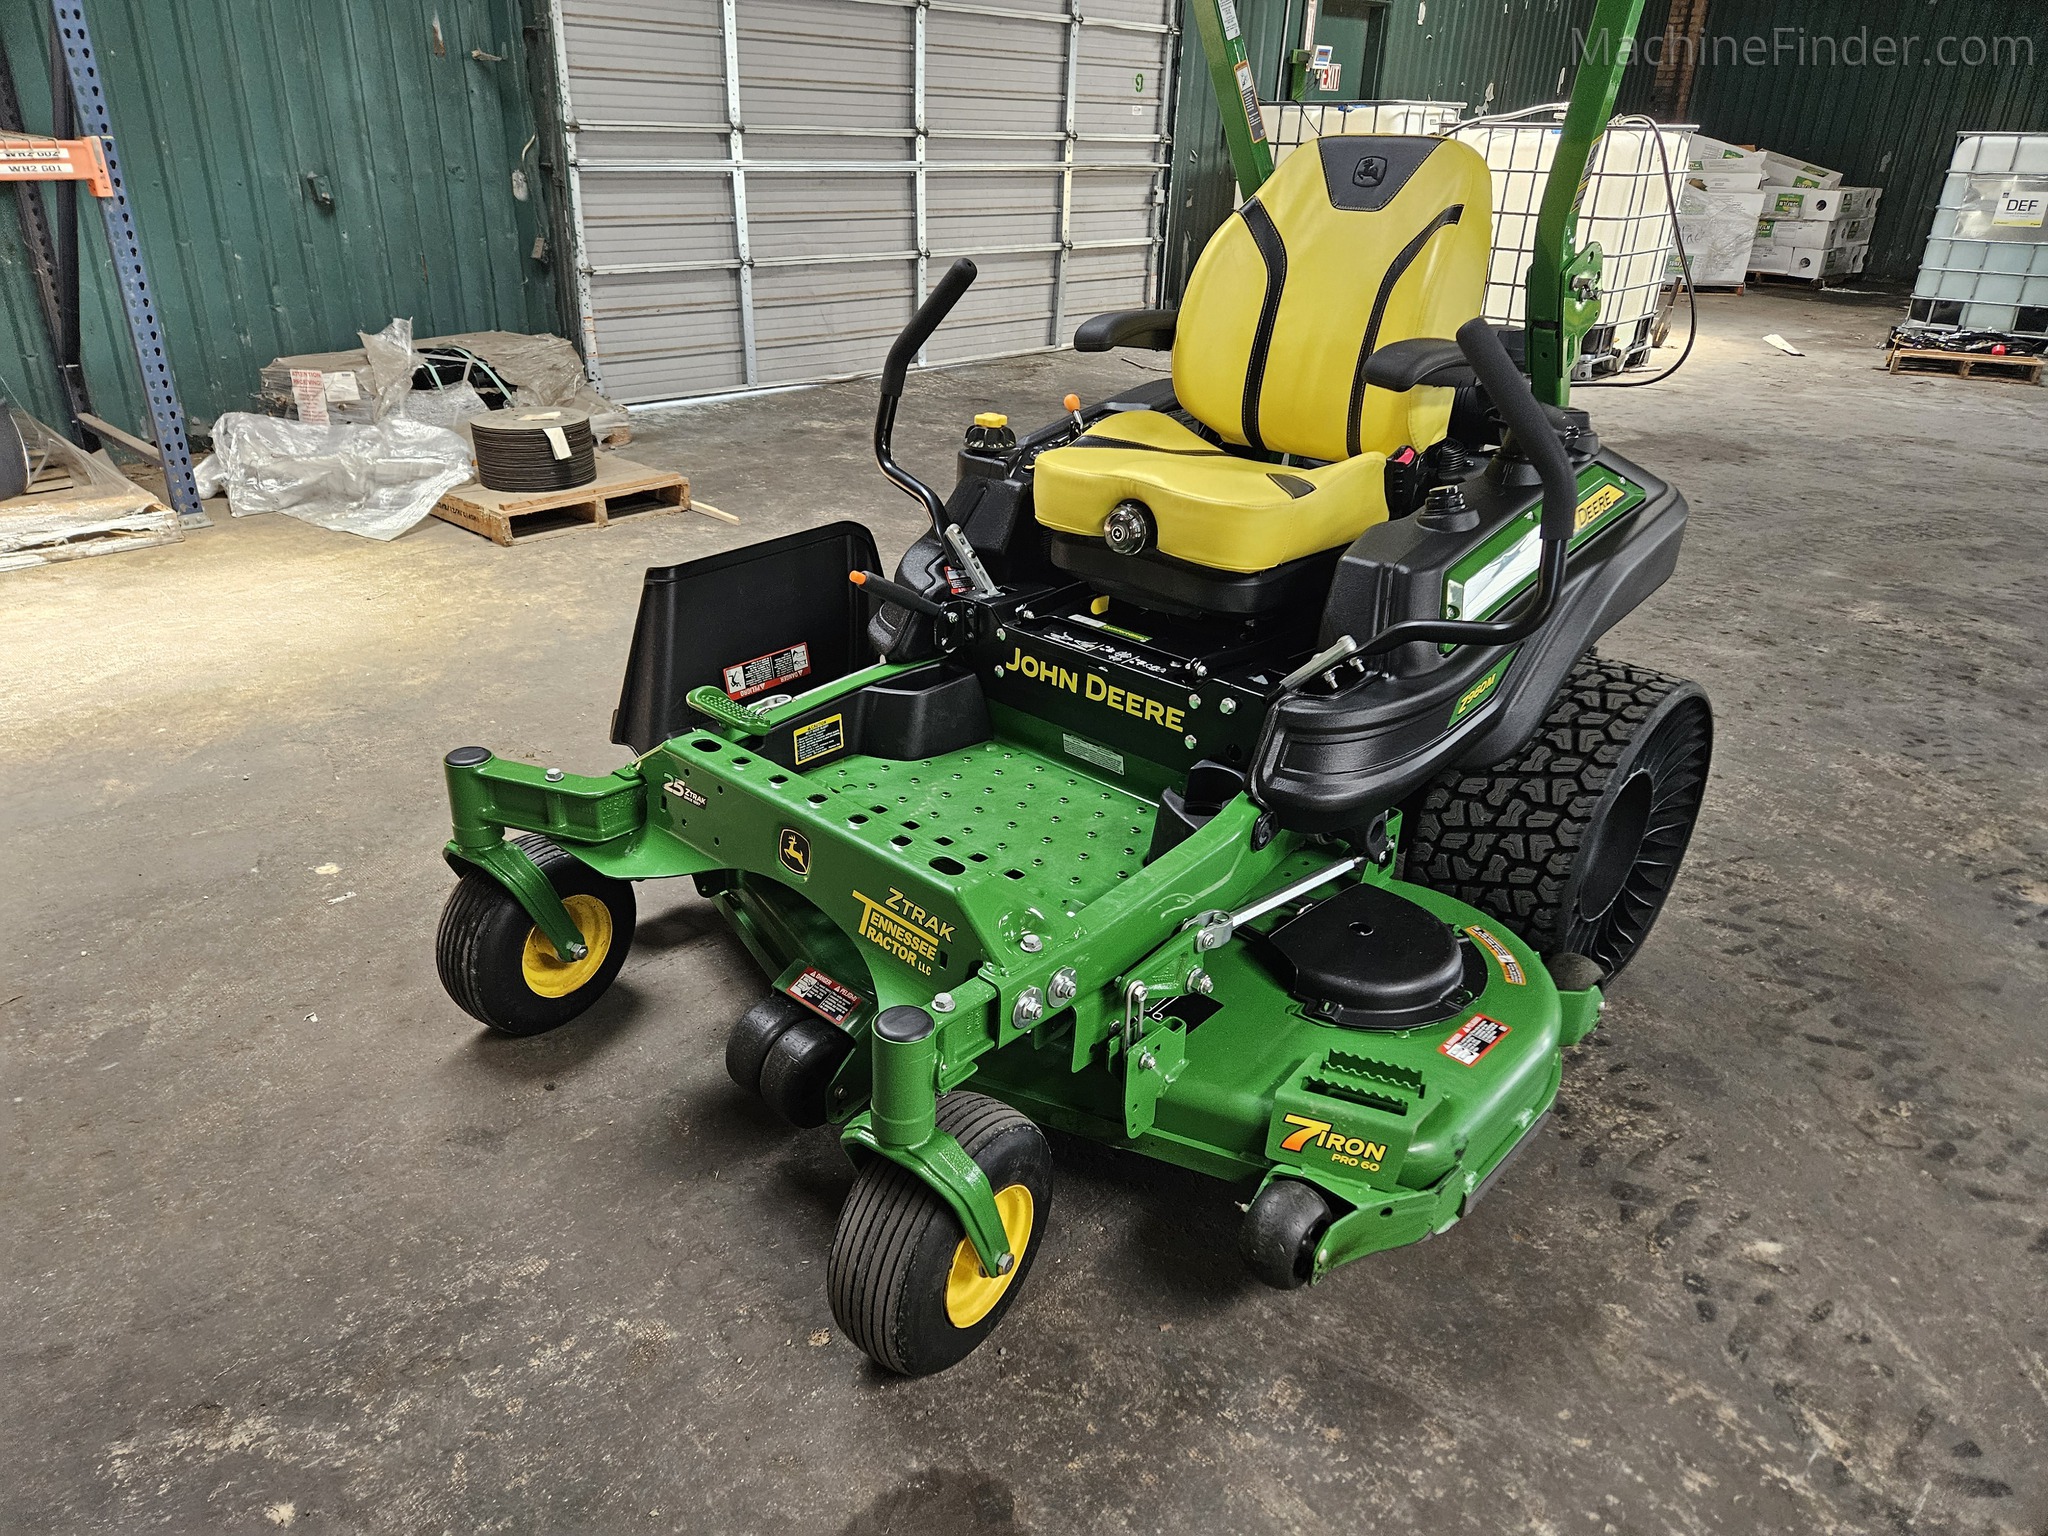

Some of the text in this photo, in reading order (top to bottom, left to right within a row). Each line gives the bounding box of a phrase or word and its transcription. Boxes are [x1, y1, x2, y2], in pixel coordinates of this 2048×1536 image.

[1321, 65, 1340, 88] EXIT
[8, 164, 38, 173] WH2
[2005, 199, 2039, 212] DEF
[1577, 491, 1613, 527] DEERE
[1005, 647, 1078, 693] JOHN
[1085, 672, 1186, 733] DEERE
[663, 772, 707, 805] 25 ZTRAK
[852, 890, 938, 961] TENNESSEE
[885, 887, 956, 943] ZTRAK
[917, 960, 932, 976] LLC
[1331, 1153, 1381, 1172] PRO 60
